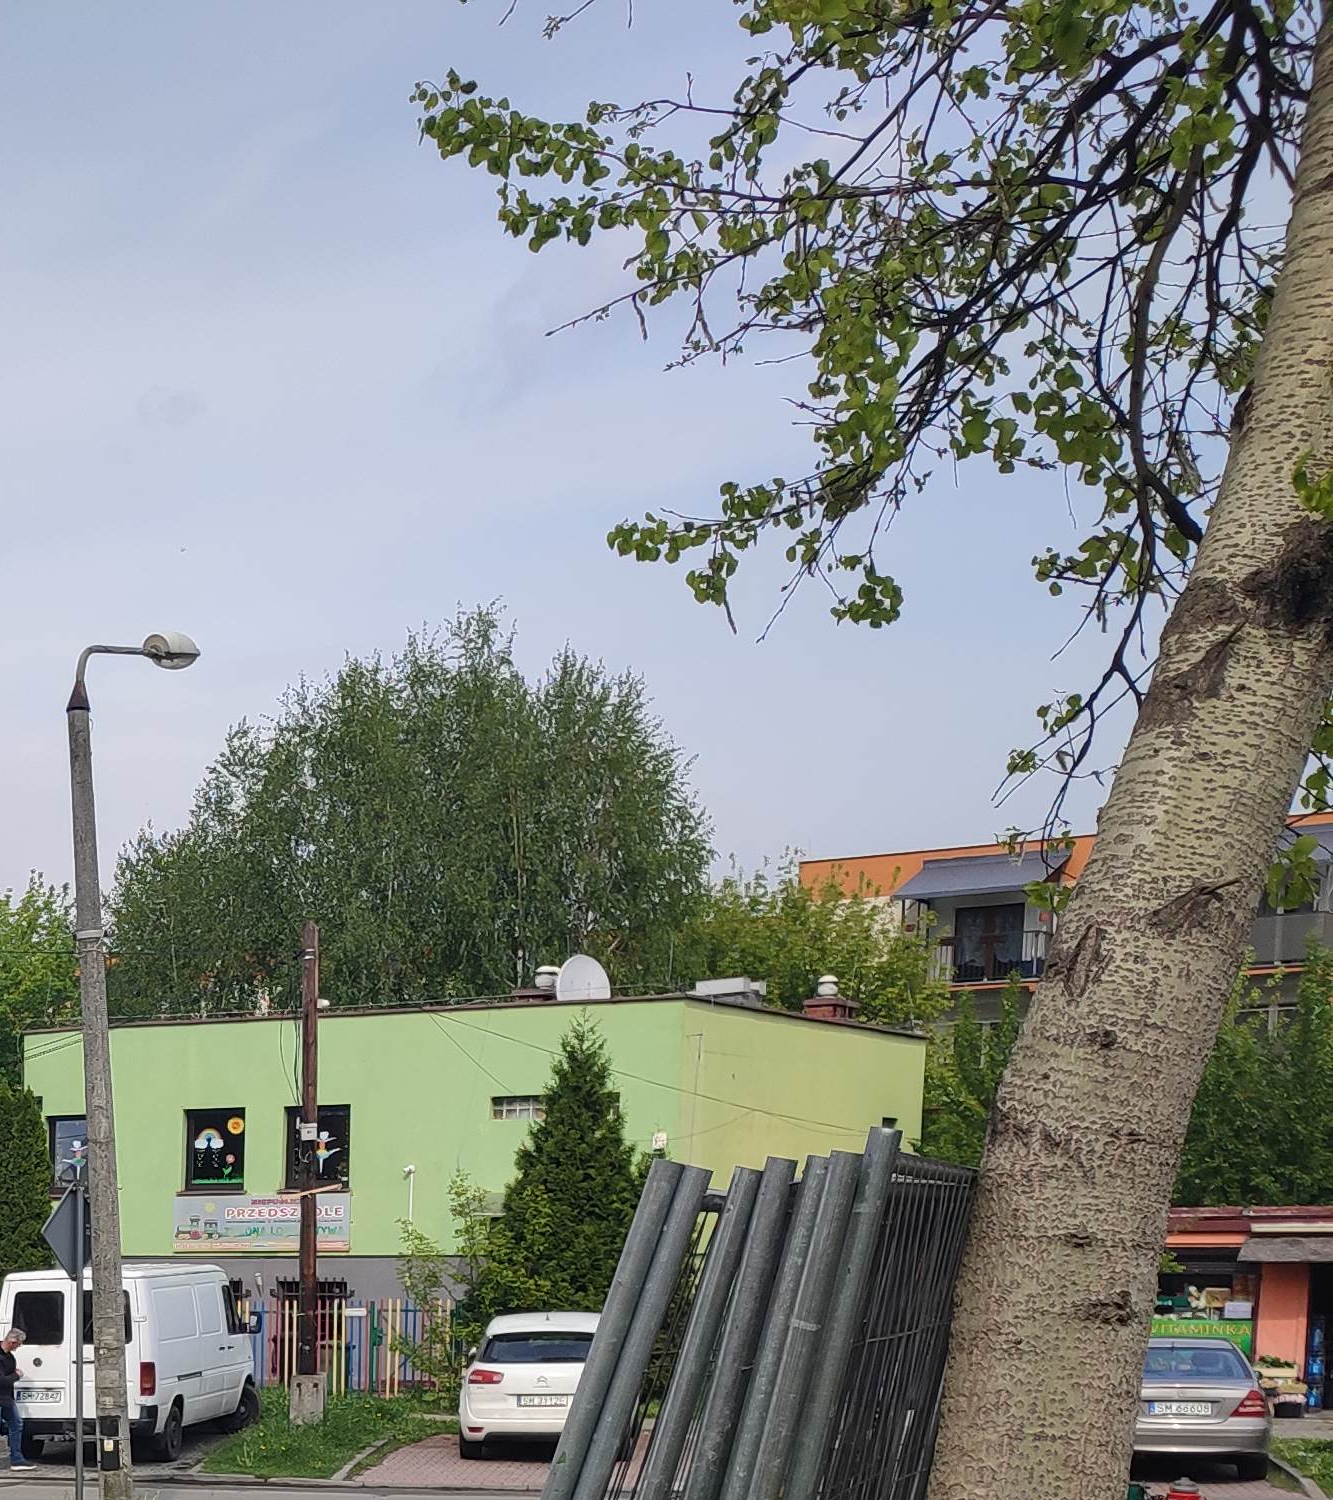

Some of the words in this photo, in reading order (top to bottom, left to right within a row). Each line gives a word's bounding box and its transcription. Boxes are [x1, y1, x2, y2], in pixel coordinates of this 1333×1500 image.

[225, 1206, 344, 1219] PRZEDSZOLE
[1150, 1323, 1252, 1335] VITAMINKA
[1157, 1403, 1173, 1413] SM
